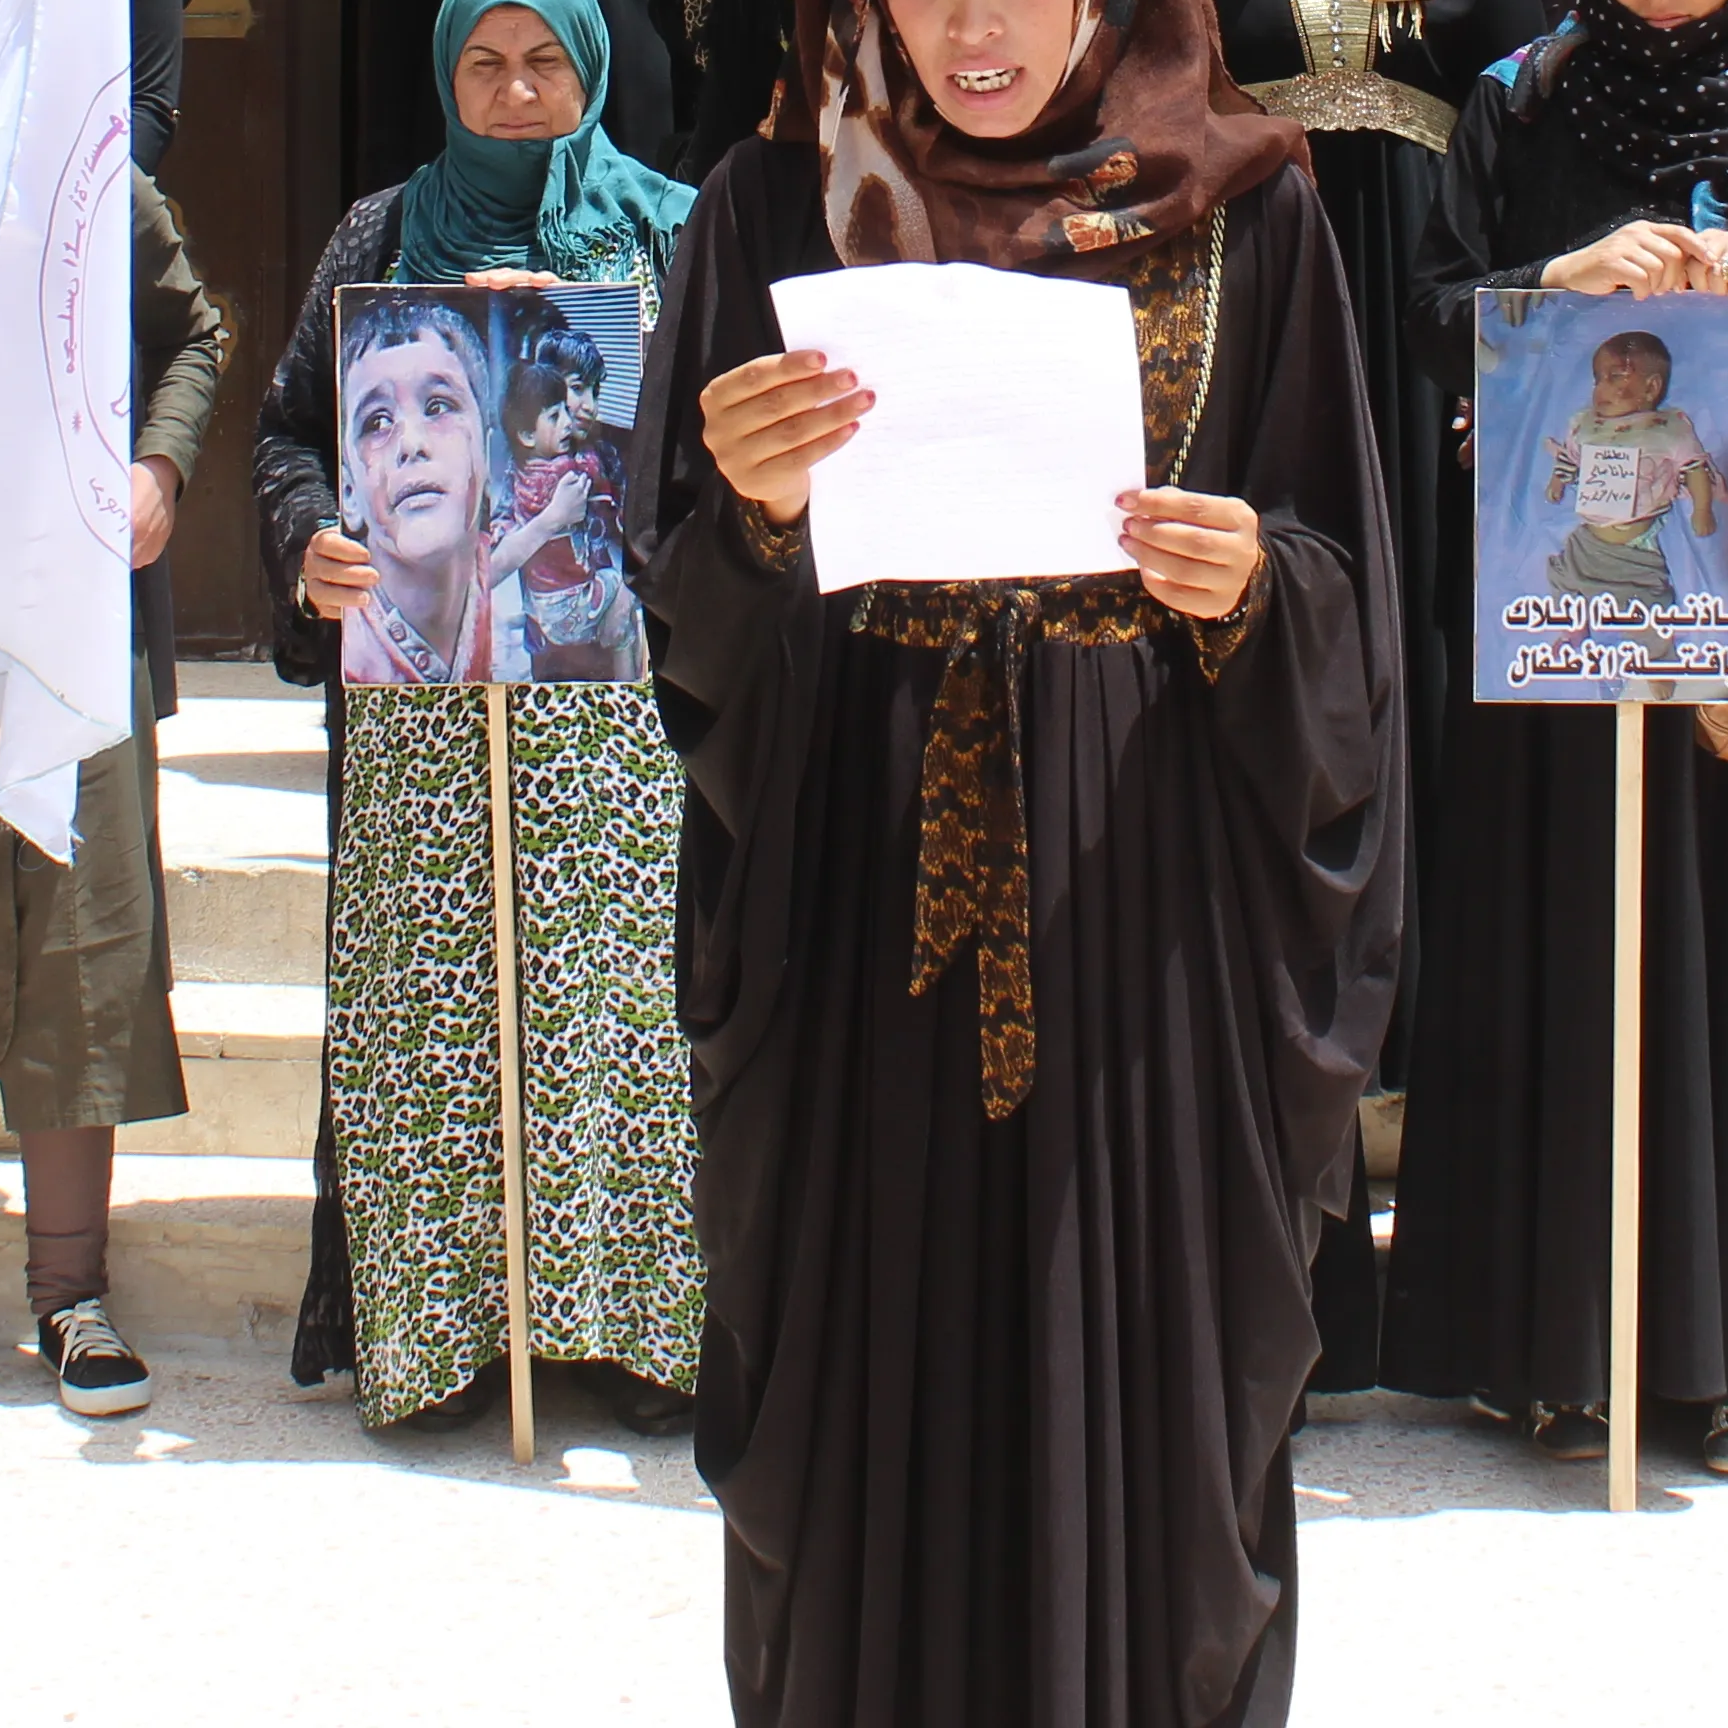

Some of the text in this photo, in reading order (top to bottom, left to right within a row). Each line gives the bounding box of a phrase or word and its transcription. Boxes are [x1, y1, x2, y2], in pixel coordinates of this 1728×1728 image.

[1504, 594, 1585, 632] الملاك
[1590, 593, 1649, 631] هذا
[1508, 638, 1617, 687] الأطفال
